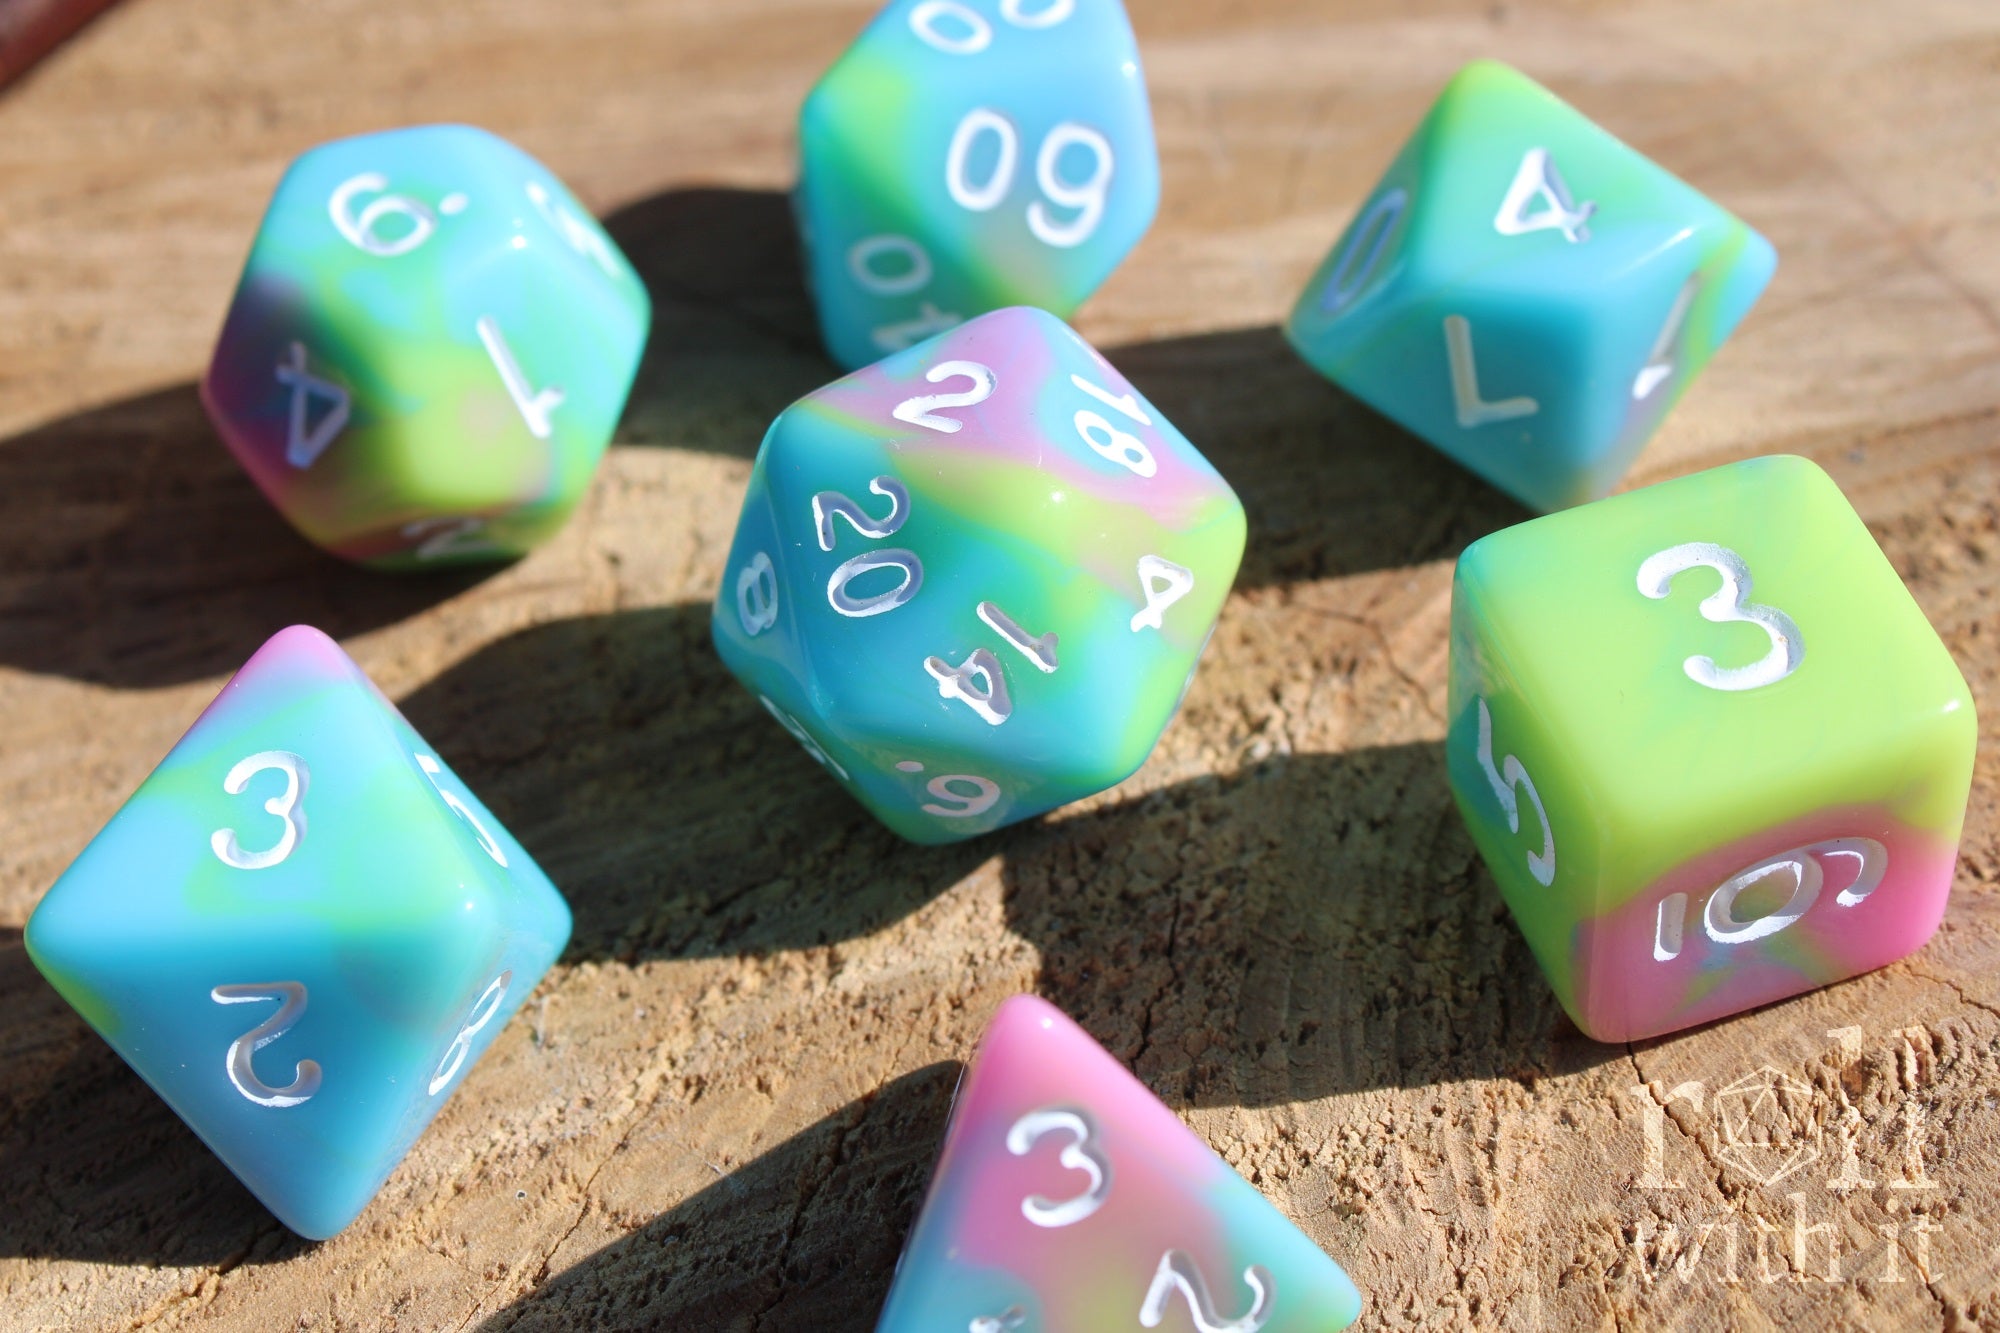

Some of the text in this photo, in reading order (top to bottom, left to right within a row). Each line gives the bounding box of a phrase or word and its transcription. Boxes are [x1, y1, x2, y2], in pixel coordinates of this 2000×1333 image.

[1494, 146, 1597, 243] 4
[275, 341, 351, 469] 4
[893, 361, 997, 433] 2
[1070, 374, 1157, 478] 18
[736, 551, 778, 637] 8
[812, 475, 924, 618] 20
[1130, 554, 1194, 632] 4
[924, 601, 1060, 726] 14
[1637, 541, 1806, 691] 3
[211, 750, 310, 869] 3
[1477, 696, 1556, 887] 5
[211, 981, 322, 1107] 2
[1006, 1104, 1113, 1228] 3
[1139, 1249, 1277, 1333] 2
